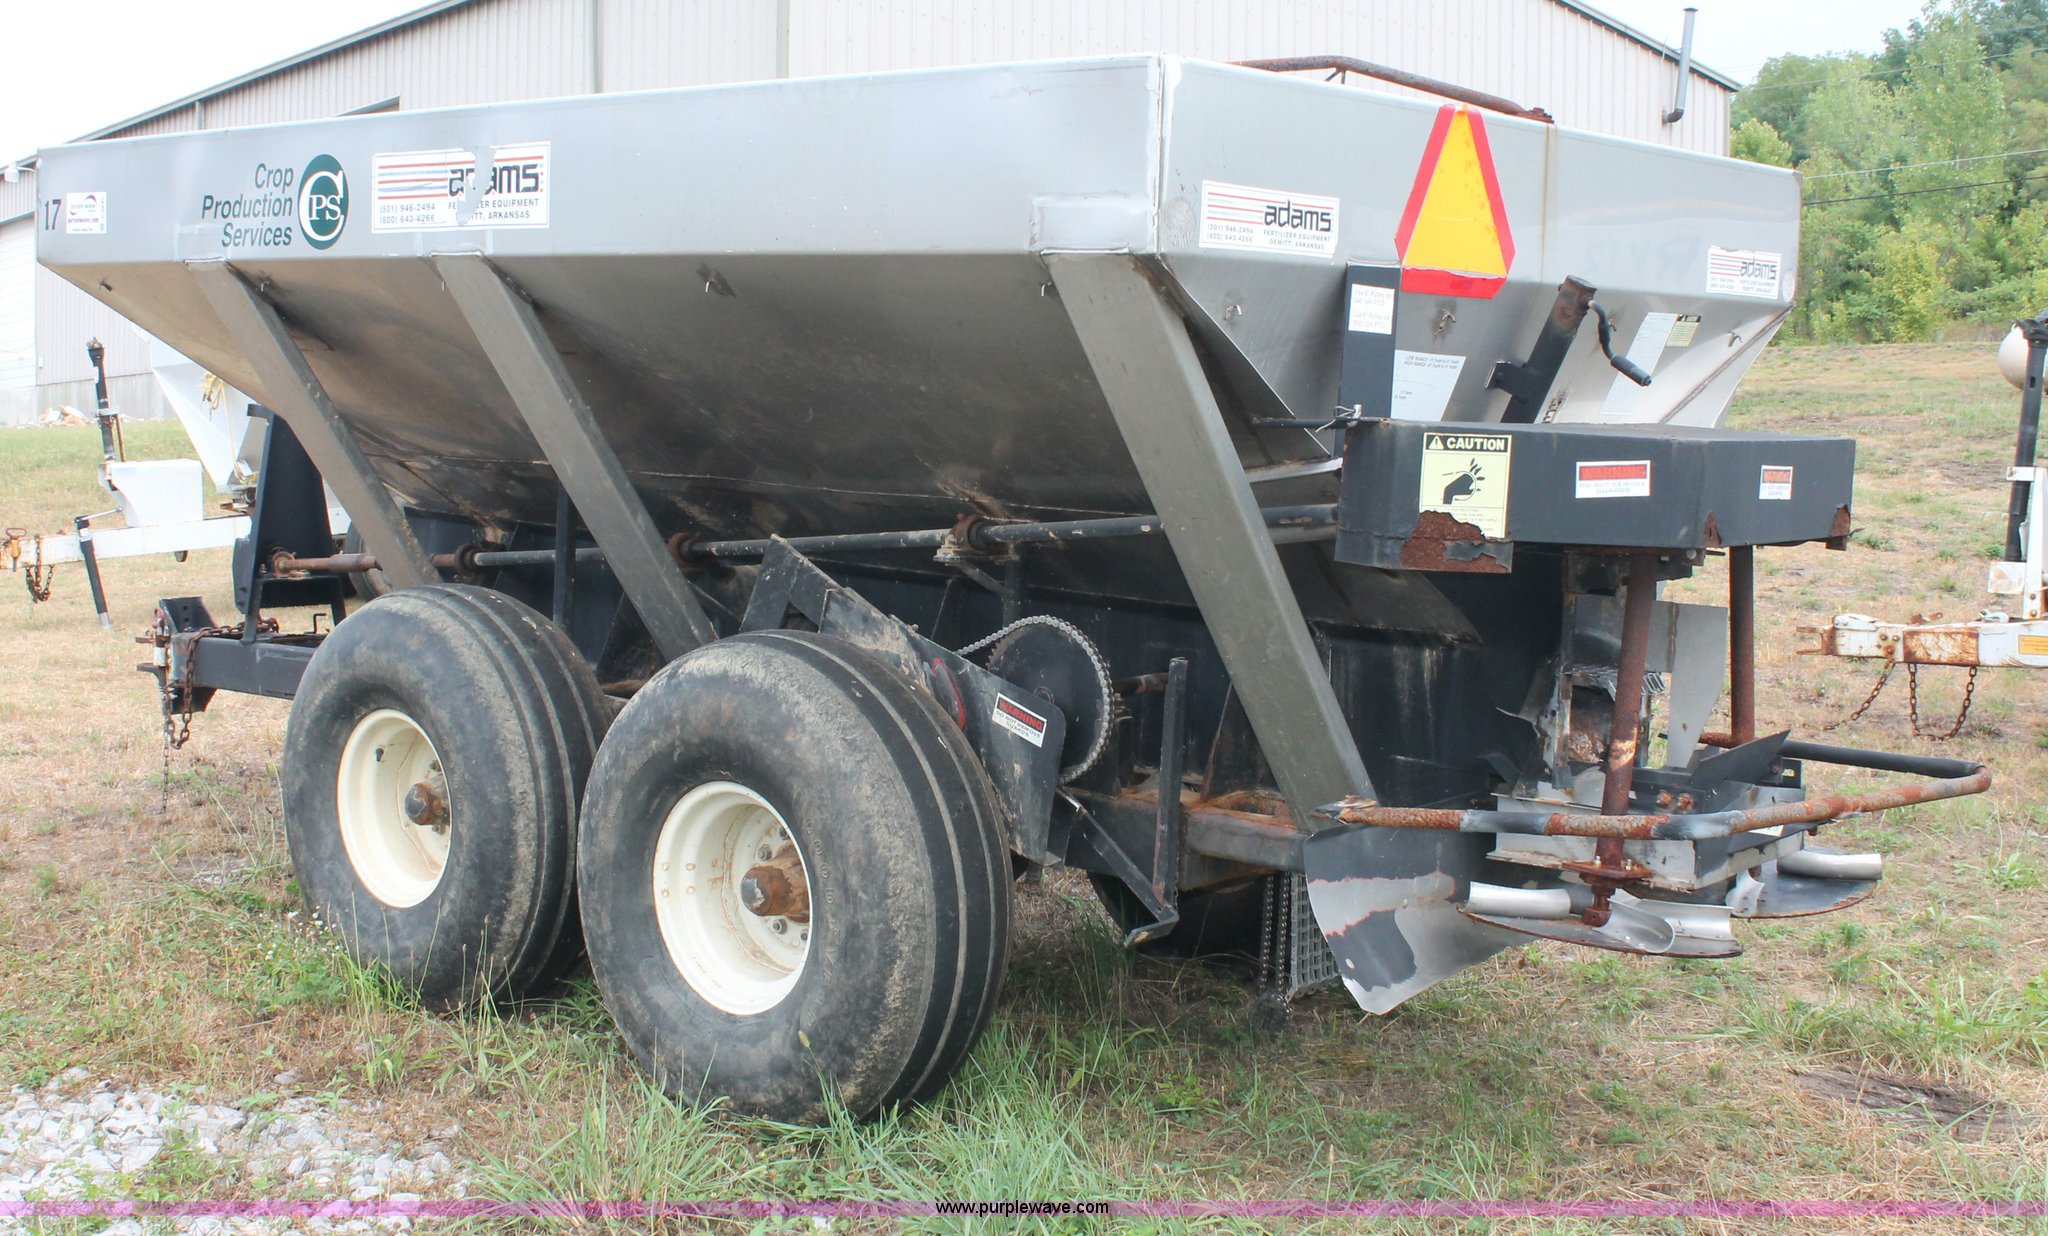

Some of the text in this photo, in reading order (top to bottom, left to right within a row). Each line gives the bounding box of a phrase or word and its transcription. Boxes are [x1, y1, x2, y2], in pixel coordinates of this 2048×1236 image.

[254, 162, 294, 194] Crop
[44, 198, 63, 231] 17
[201, 192, 293, 220] Production
[488, 209, 531, 220] ARKANSAS
[492, 198, 540, 209] EQUIPMENT
[1264, 199, 1332, 233] adams
[221, 221, 293, 248] Services
[1263, 229, 1297, 238] FERTILIZER
[1739, 256, 1777, 281] adams
[1446, 437, 1505, 451] CAUTION
[995, 710, 1041, 739] DO NOT REMOVE
[998, 698, 1044, 731] WARNING
[1005, 720, 1031, 737] GUARDS
